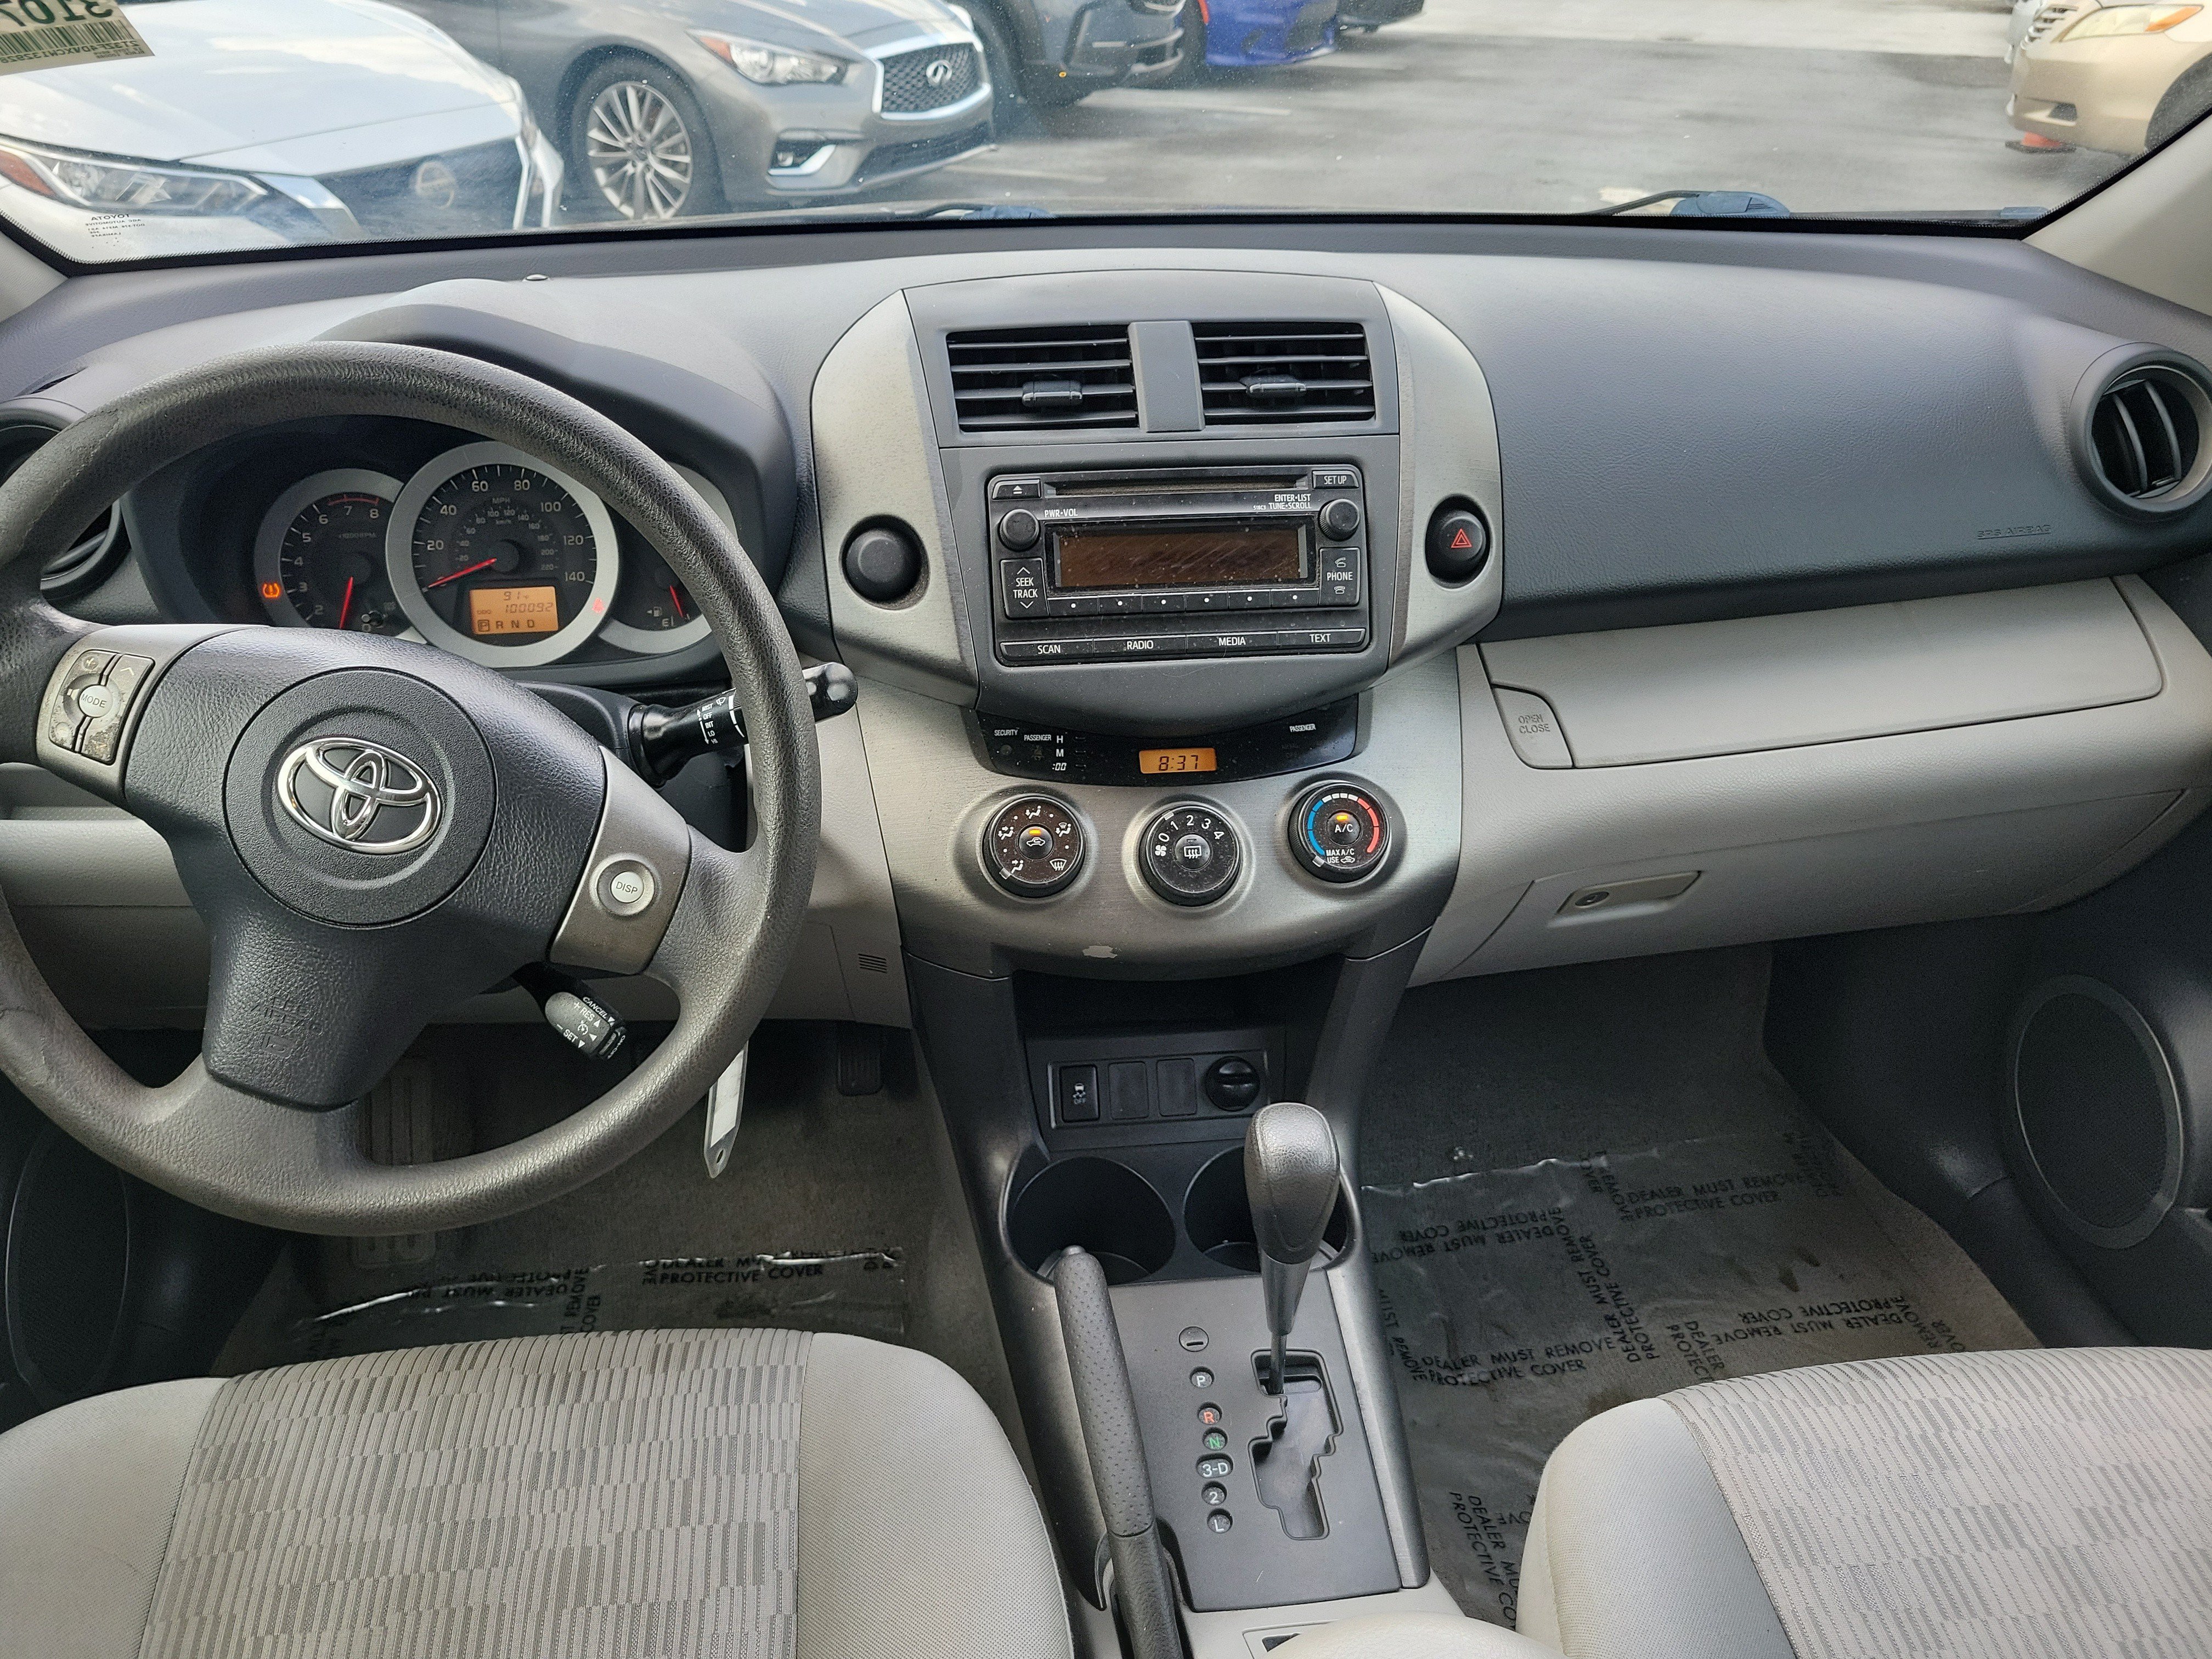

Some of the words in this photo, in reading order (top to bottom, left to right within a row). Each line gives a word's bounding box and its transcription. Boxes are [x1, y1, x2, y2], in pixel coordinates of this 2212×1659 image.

[514, 479, 531, 491] 80
[1324, 476, 1337, 485] SET
[1338, 476, 1347, 484] UP
[472, 481, 489, 492] 60
[344, 506, 353, 515] 7
[440, 505, 456, 515] 40
[541, 501, 561, 512] 100
[319, 514, 329, 524] 6
[370, 509, 380, 518] 8
[2006, 524, 2052, 535] AIRBAG
[302, 533, 312, 542] 5
[563, 535, 584, 546] 120
[427, 540, 444, 550] 20
[294, 556, 304, 566] 4
[564, 572, 586, 582] 140
[1015, 577, 1034, 586] SEEK
[1327, 572, 1353, 581] PHONE
[299, 582, 308, 592] 3
[1013, 589, 1038, 599] TRACK
[314, 605, 324, 615] 2
[511, 620, 520, 628] N
[527, 619, 534, 628] D
[1218, 636, 1246, 646] MEDIA
[1309, 633, 1331, 643] TEXT
[1037, 645, 1061, 654] SCAN
[1126, 640, 1154, 650] RADIO
[81, 693, 107, 708] MODE
[702, 703, 713, 712] MIST
[703, 712, 713, 720] OFF
[1518, 714, 1543, 724] OPEN
[704, 720, 714, 729] INT
[1289, 723, 1316, 732] PASSENGER
[1519, 724, 1550, 734] CLOSE
[1056, 735, 1063, 743] H
[1056, 749, 1064, 757] M
[1159, 755, 1198, 771] 8:37
[1170, 821, 1179, 831] 1
[1186, 815, 1194, 826] 2
[1201, 818, 1211, 829] 3
[1334, 823, 1353, 833] A/C
[1158, 833, 1170, 842] 0
[1214, 831, 1224, 839] 4
[1341, 848, 1355, 856] A/C
[616, 881, 639, 894] DISP
[583, 996, 608, 1019] CANCEL
[580, 1007, 595, 1022] RES
[563, 1029, 578, 1042] SET
[1627, 1187, 1683, 1205] DEALER
[1692, 1179, 1735, 1197] MUST
[1634, 1196, 1725, 1219] PROTECTIVE
[1729, 1189, 1779, 1207] COVER
[1459, 1212, 1548, 1233] PROTECTIVE
[1400, 1224, 1450, 1242] COVER
[1496, 1225, 1555, 1244] DEALER
[1443, 1235, 1486, 1253] MUST
[1373, 1242, 1437, 1263] REMOVE
[1579, 1235, 1611, 1278] COVER
[659, 1268, 760, 1284] PROTECTIVE
[768, 1263, 823, 1280] COVER
[1578, 1269, 1607, 1305] MUST
[1800, 1298, 1892, 1318] PROTECTIVE
[1604, 1281, 1660, 1361] PROTECTIVE
[1738, 1307, 1793, 1325] COVER
[1842, 1312, 1904, 1330] DEALER
[1792, 1319, 1834, 1335] MUST
[1604, 1313, 1641, 1363] DEALER
[1711, 1325, 1783, 1346] REMOVE
[1684, 1320, 1725, 1370] DEALER
[1422, 1353, 1480, 1372] DEALER
[1491, 1347, 1534, 1365] MUST
[1544, 1337, 1617, 1359] REMOVE
[1532, 1359, 1587, 1377] COVER
[1196, 1375, 1206, 1386] P
[1204, 1411, 1215, 1423] R
[1209, 1436, 1222, 1449] N
[1202, 1462, 1229, 1477] 3-D
[1209, 1491, 1219, 1504] 2
[1214, 1520, 1224, 1532] L
[1468, 1494, 1506, 1550] DEALER
[1449, 1491, 1499, 1586] PROTECTIVE
